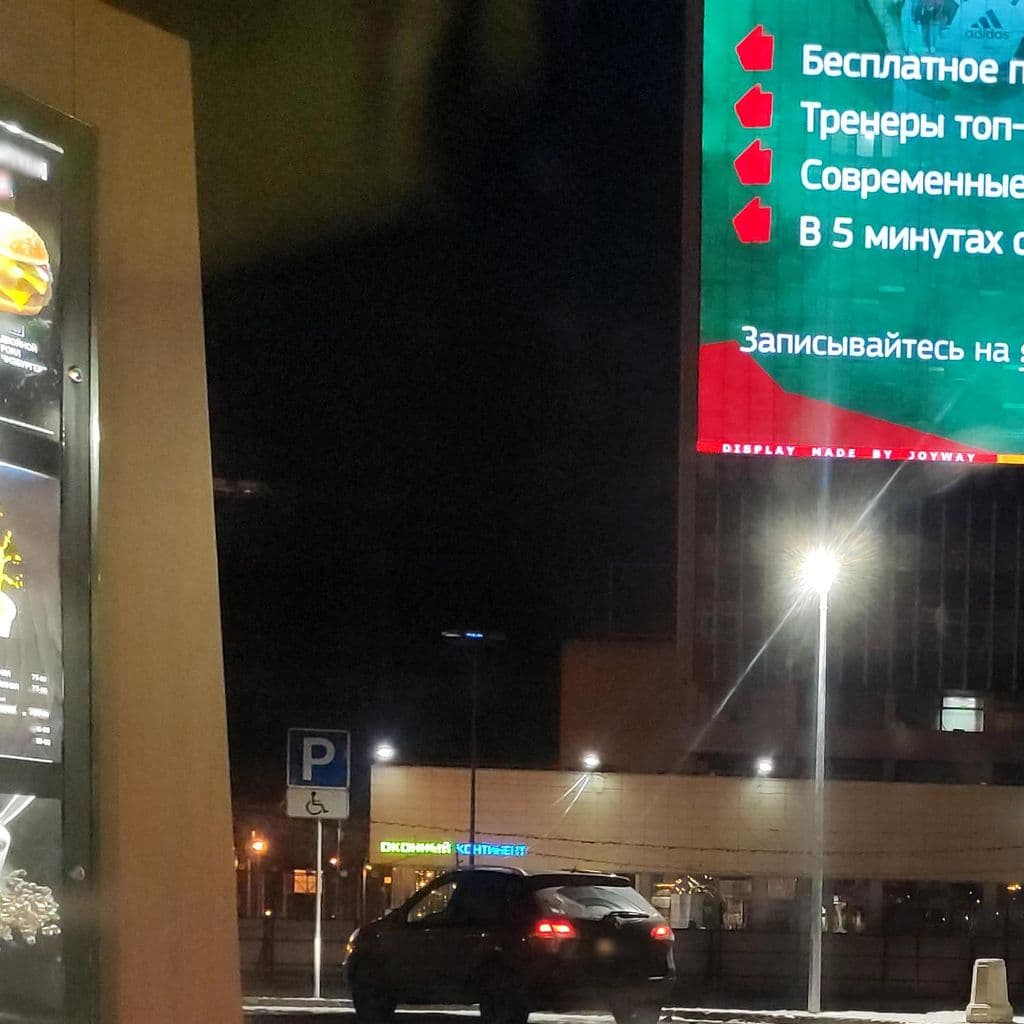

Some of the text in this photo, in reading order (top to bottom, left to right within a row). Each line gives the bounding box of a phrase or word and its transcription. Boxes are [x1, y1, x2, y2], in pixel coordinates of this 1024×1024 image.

[965, 28, 1009, 40] adidas
[802, 44, 998, 84] Бесплатное
[800, 101, 945, 141] Тренеры
[800, 216, 821, 248] В
[832, 217, 854, 249] 5
[865, 222, 1003, 257] минутах
[739, 325, 965, 362] Записывайтесь
[975, 342, 1010, 362] на
[722, 443, 976, 463] DISPLAY MADE BY JOYWAY
[302, 737, 335, 781] P
